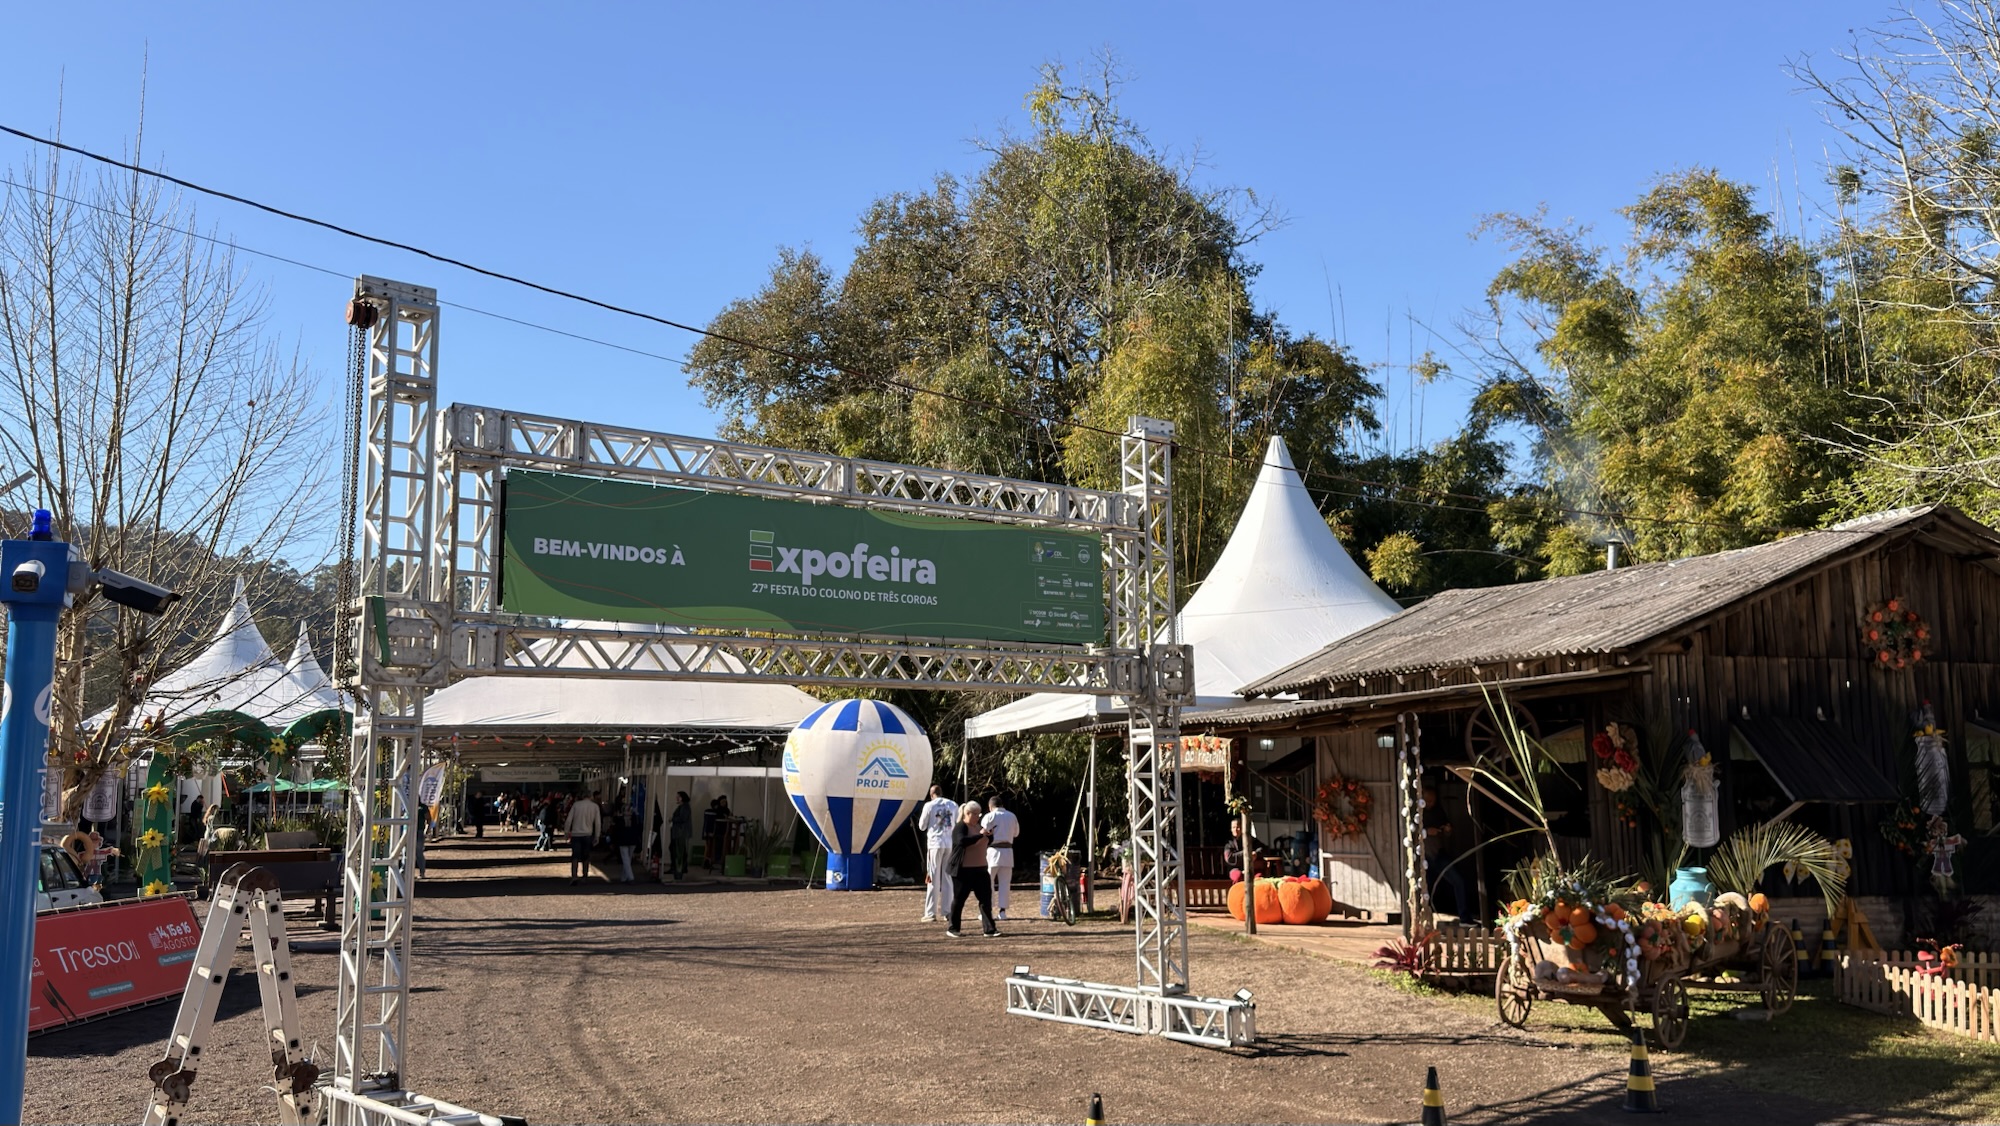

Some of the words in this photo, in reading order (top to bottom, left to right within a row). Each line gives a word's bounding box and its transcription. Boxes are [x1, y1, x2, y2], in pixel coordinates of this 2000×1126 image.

[533, 537, 667, 564] BEM-VINDOS
[670, 544, 686, 566] À
[770, 585, 800, 596] FESTA
[802, 587, 817, 597] DO
[819, 588, 861, 601] COLONO
[863, 591, 876, 601] DE
[878, 590, 899, 602] TRÊS
[901, 594, 938, 606] COROAS
[163, 936, 197, 950] AGOSTO
